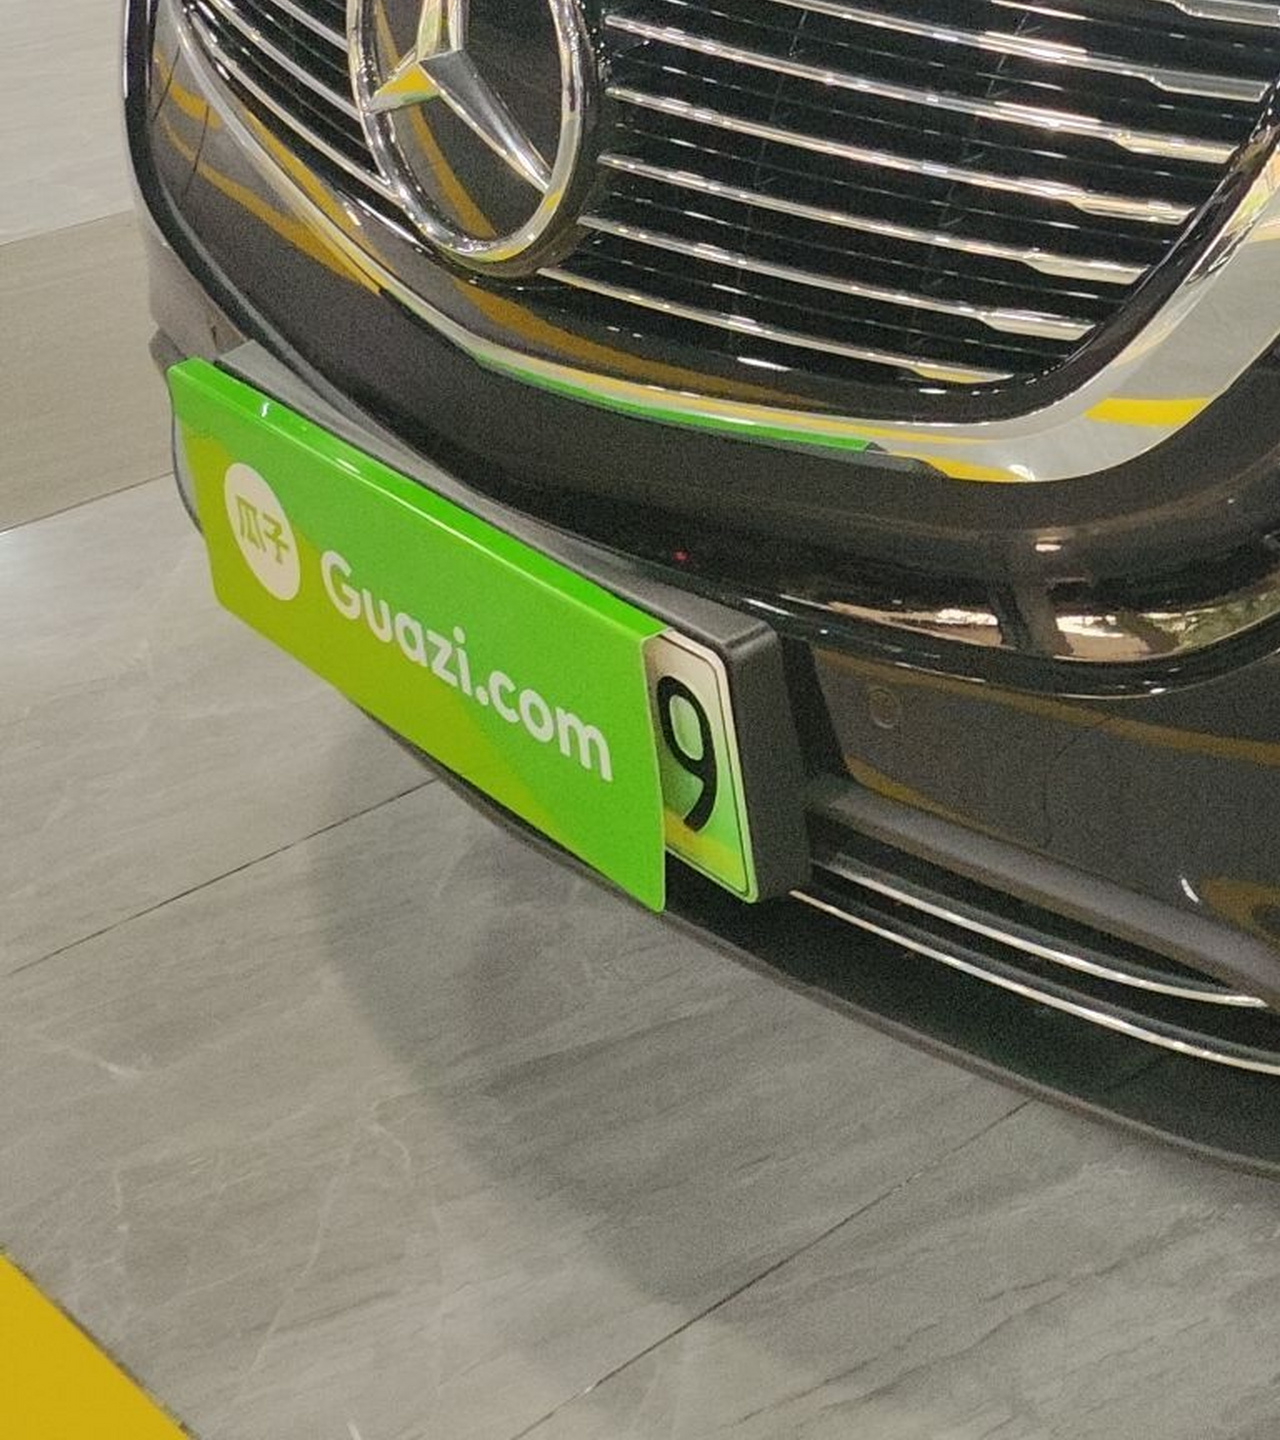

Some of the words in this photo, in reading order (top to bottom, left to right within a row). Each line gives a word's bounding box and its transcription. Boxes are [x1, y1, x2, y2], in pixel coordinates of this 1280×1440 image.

[235, 495, 289, 565] 瓜子
[320, 550, 613, 782] Guazi.com
[657, 674, 718, 833] 9
